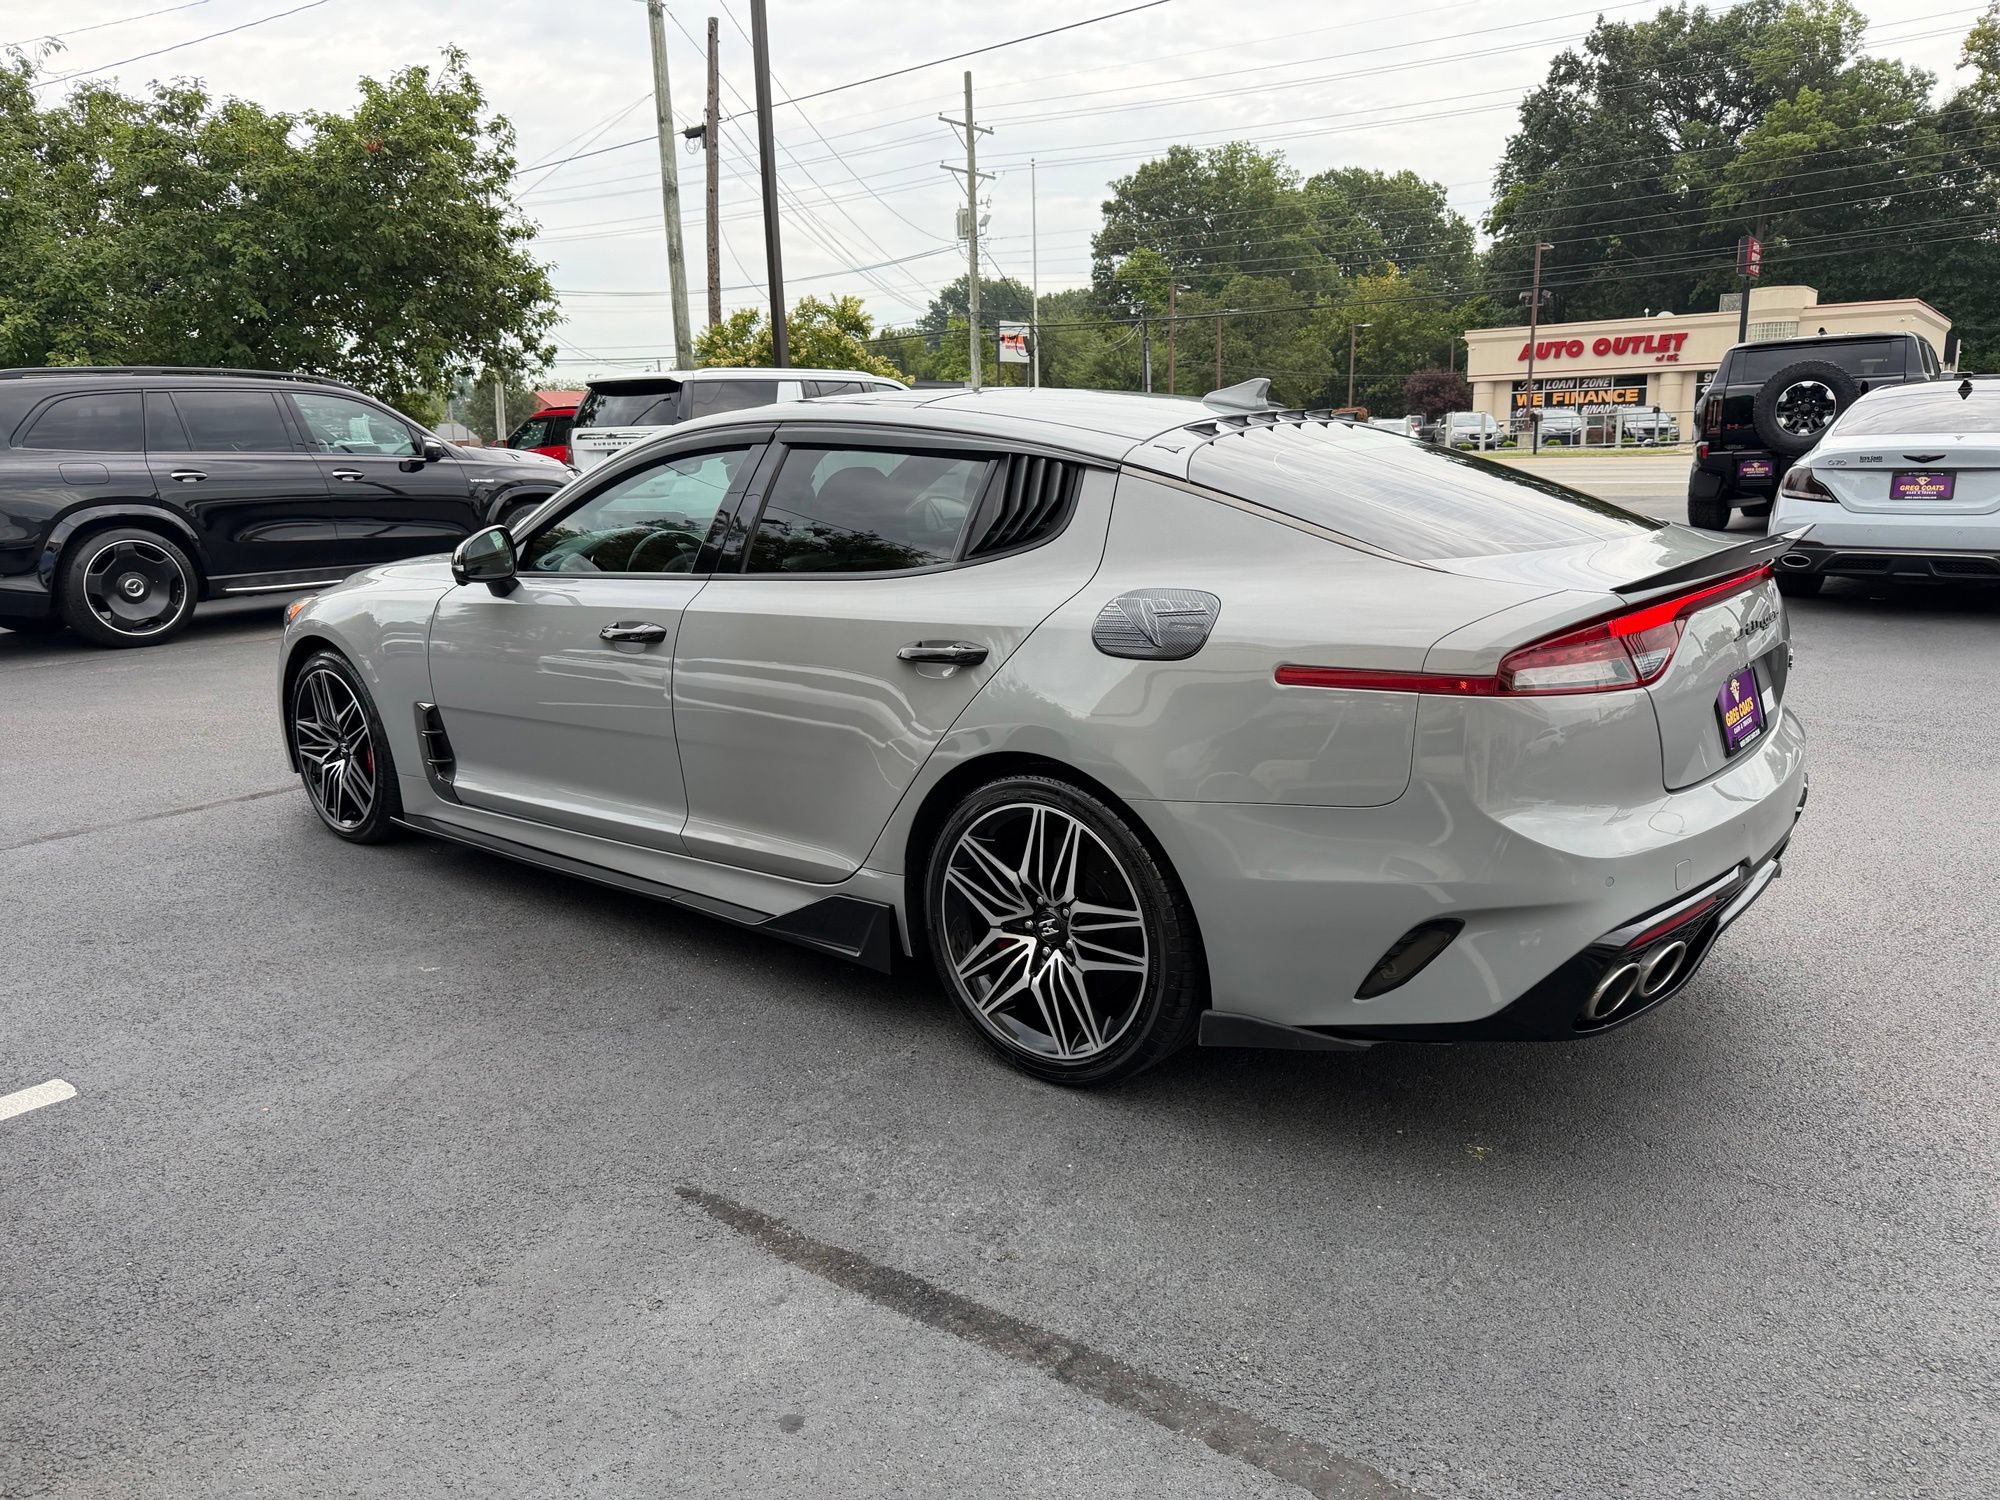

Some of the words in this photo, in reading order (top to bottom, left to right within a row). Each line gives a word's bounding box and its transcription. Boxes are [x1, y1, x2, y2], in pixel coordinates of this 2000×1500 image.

[1518, 339, 1584, 361] AUTO
[1592, 332, 1688, 356] OUTLET
[1518, 381, 1539, 391] Te
[1545, 379, 1574, 390] LOAN
[1581, 377, 1611, 388] ZONE
[1516, 393, 1543, 407] WE
[1552, 388, 1640, 405] FINANCE
[1725, 706, 1740, 727] GREG
[1739, 696, 1754, 717] COATS
